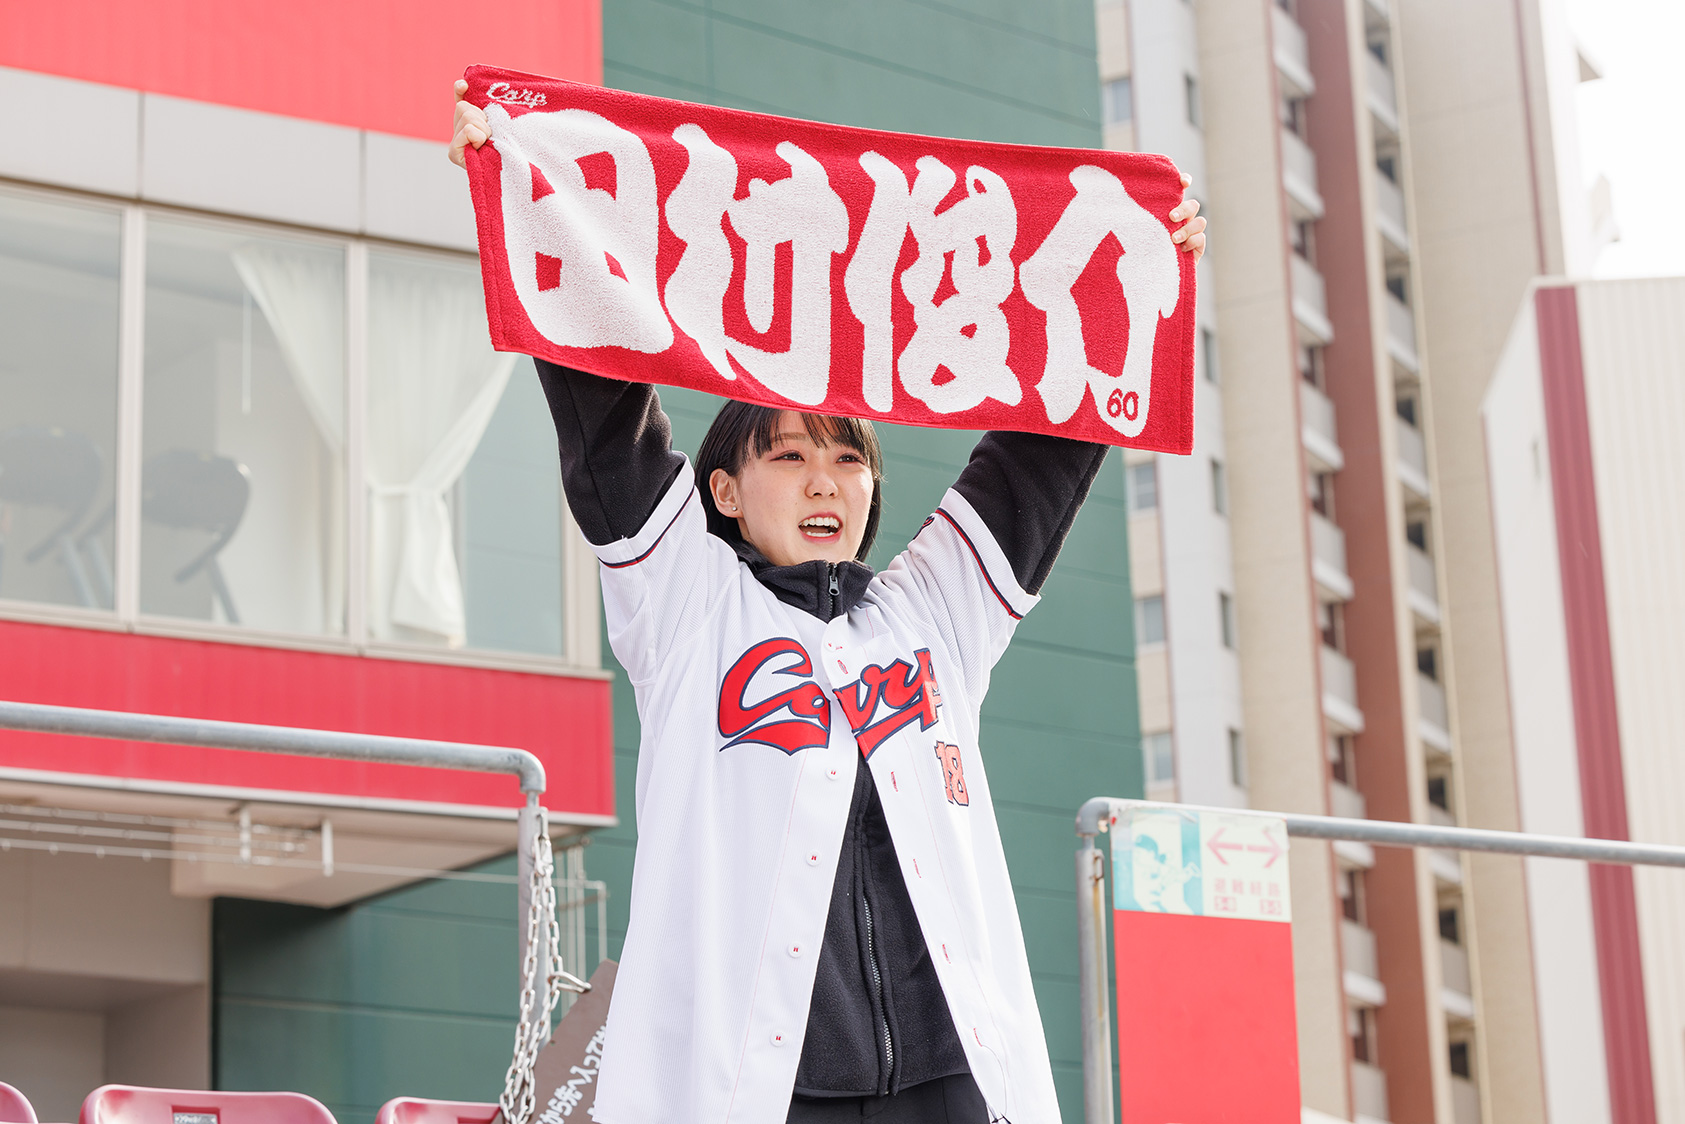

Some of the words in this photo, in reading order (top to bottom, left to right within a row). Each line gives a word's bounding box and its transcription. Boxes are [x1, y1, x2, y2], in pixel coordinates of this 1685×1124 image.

[486, 81, 548, 108] Carp
[484, 102, 1181, 438] 田村俊介
[1106, 387, 1140, 422] 60
[934, 740, 970, 807] 18
